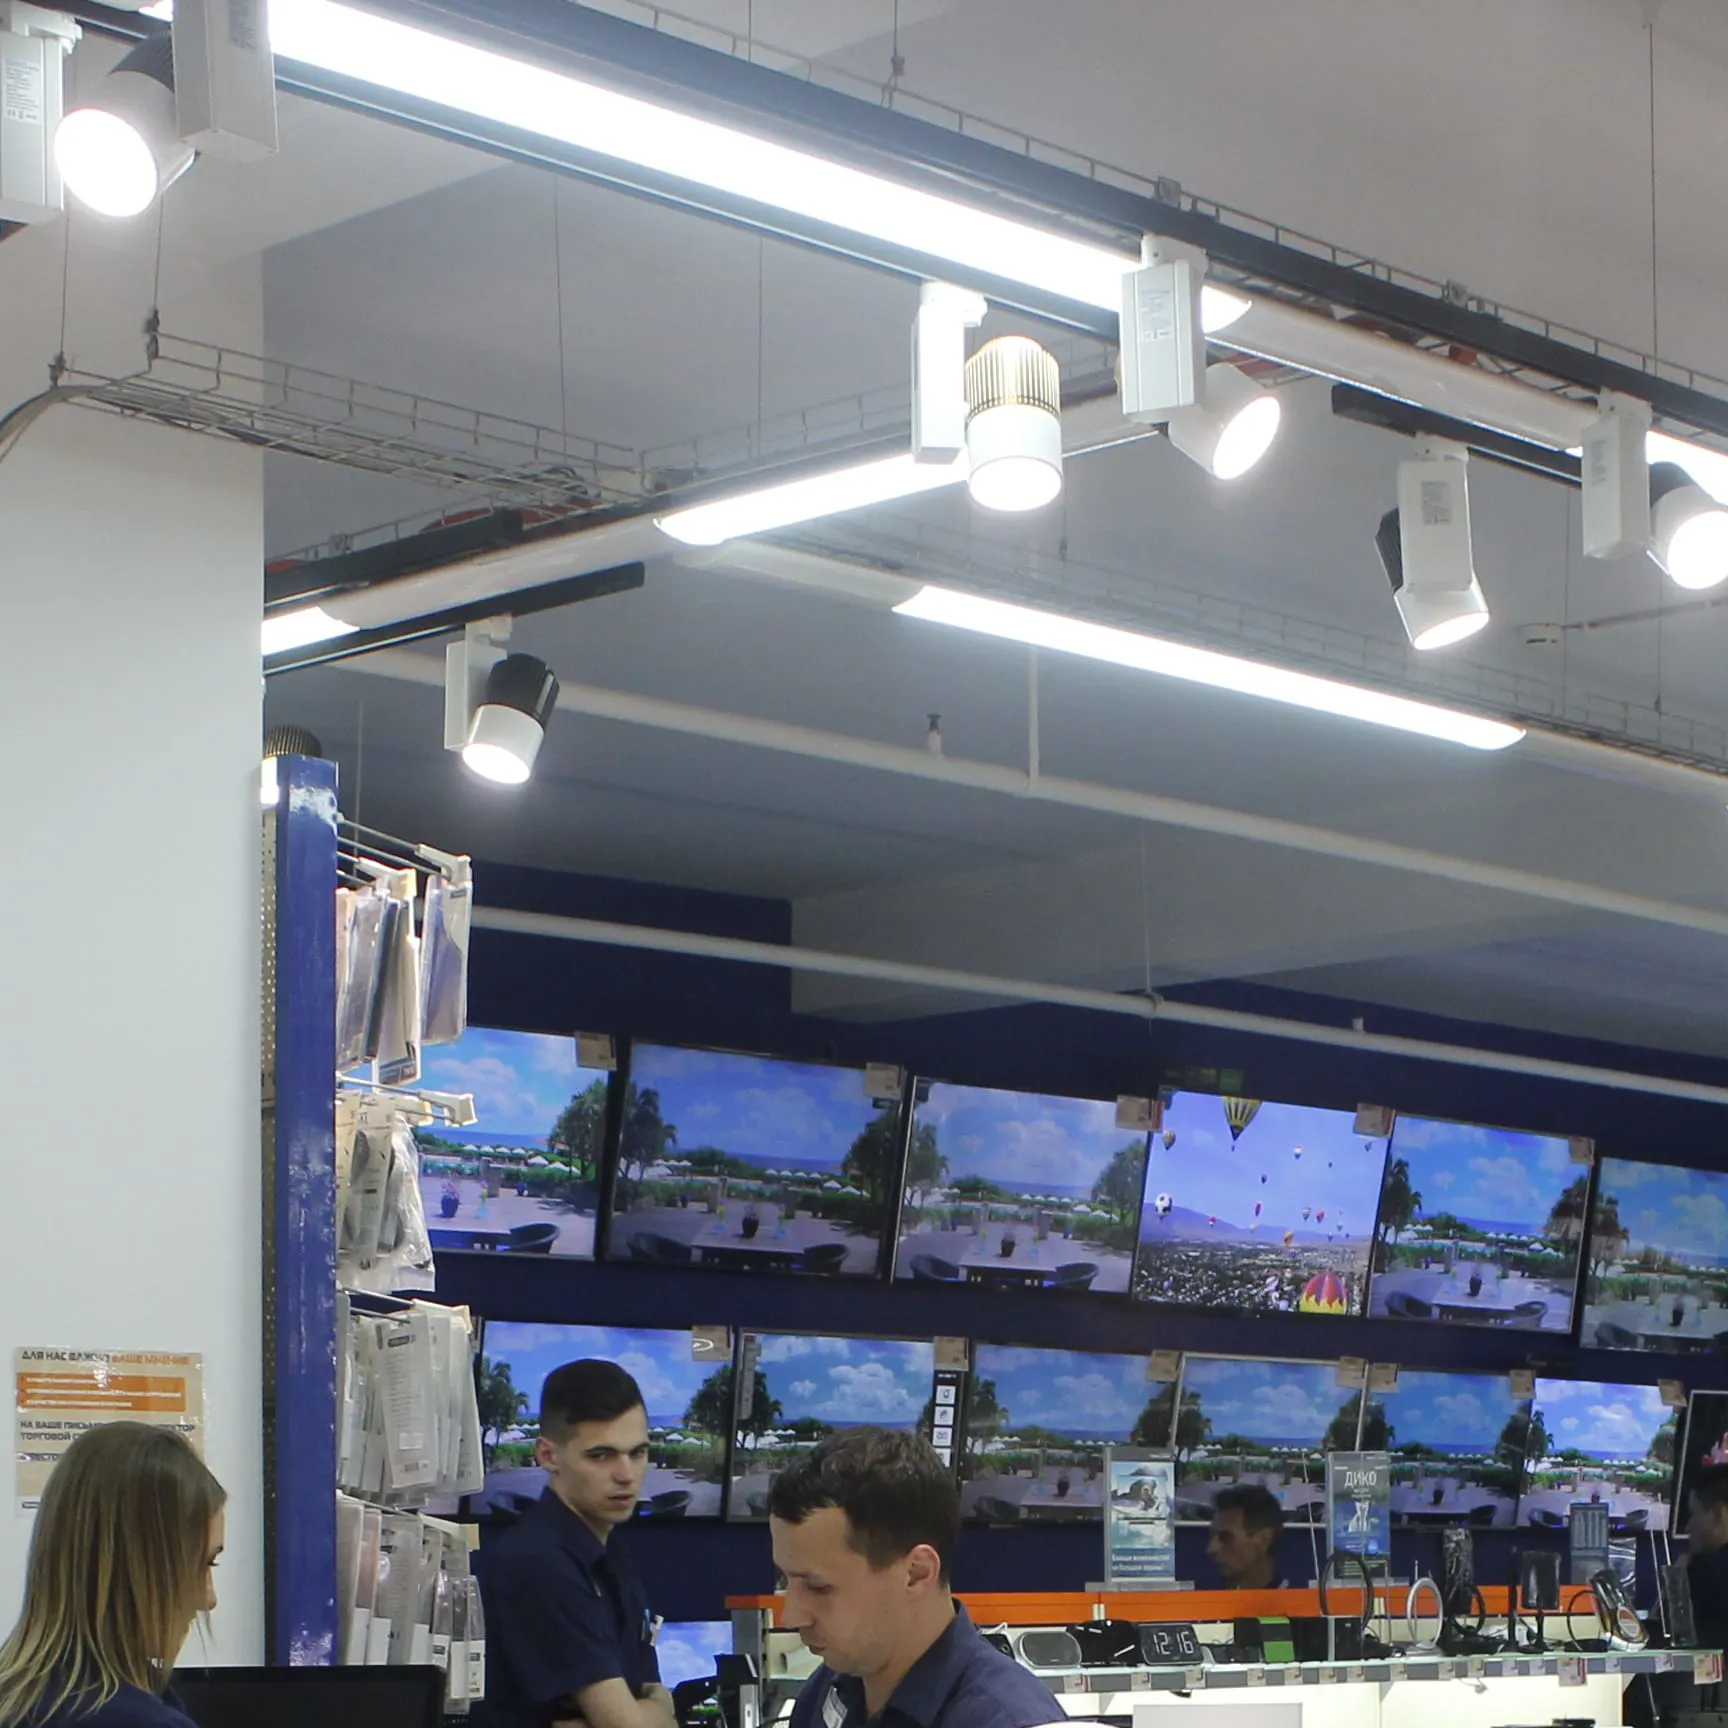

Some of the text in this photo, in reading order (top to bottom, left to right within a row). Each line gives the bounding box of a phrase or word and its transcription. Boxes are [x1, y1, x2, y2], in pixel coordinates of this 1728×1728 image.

[22, 1351, 44, 1361] ДЛЯ
[46, 1351, 67, 1361] НАС
[1344, 1471, 1377, 1488] ДИКО
